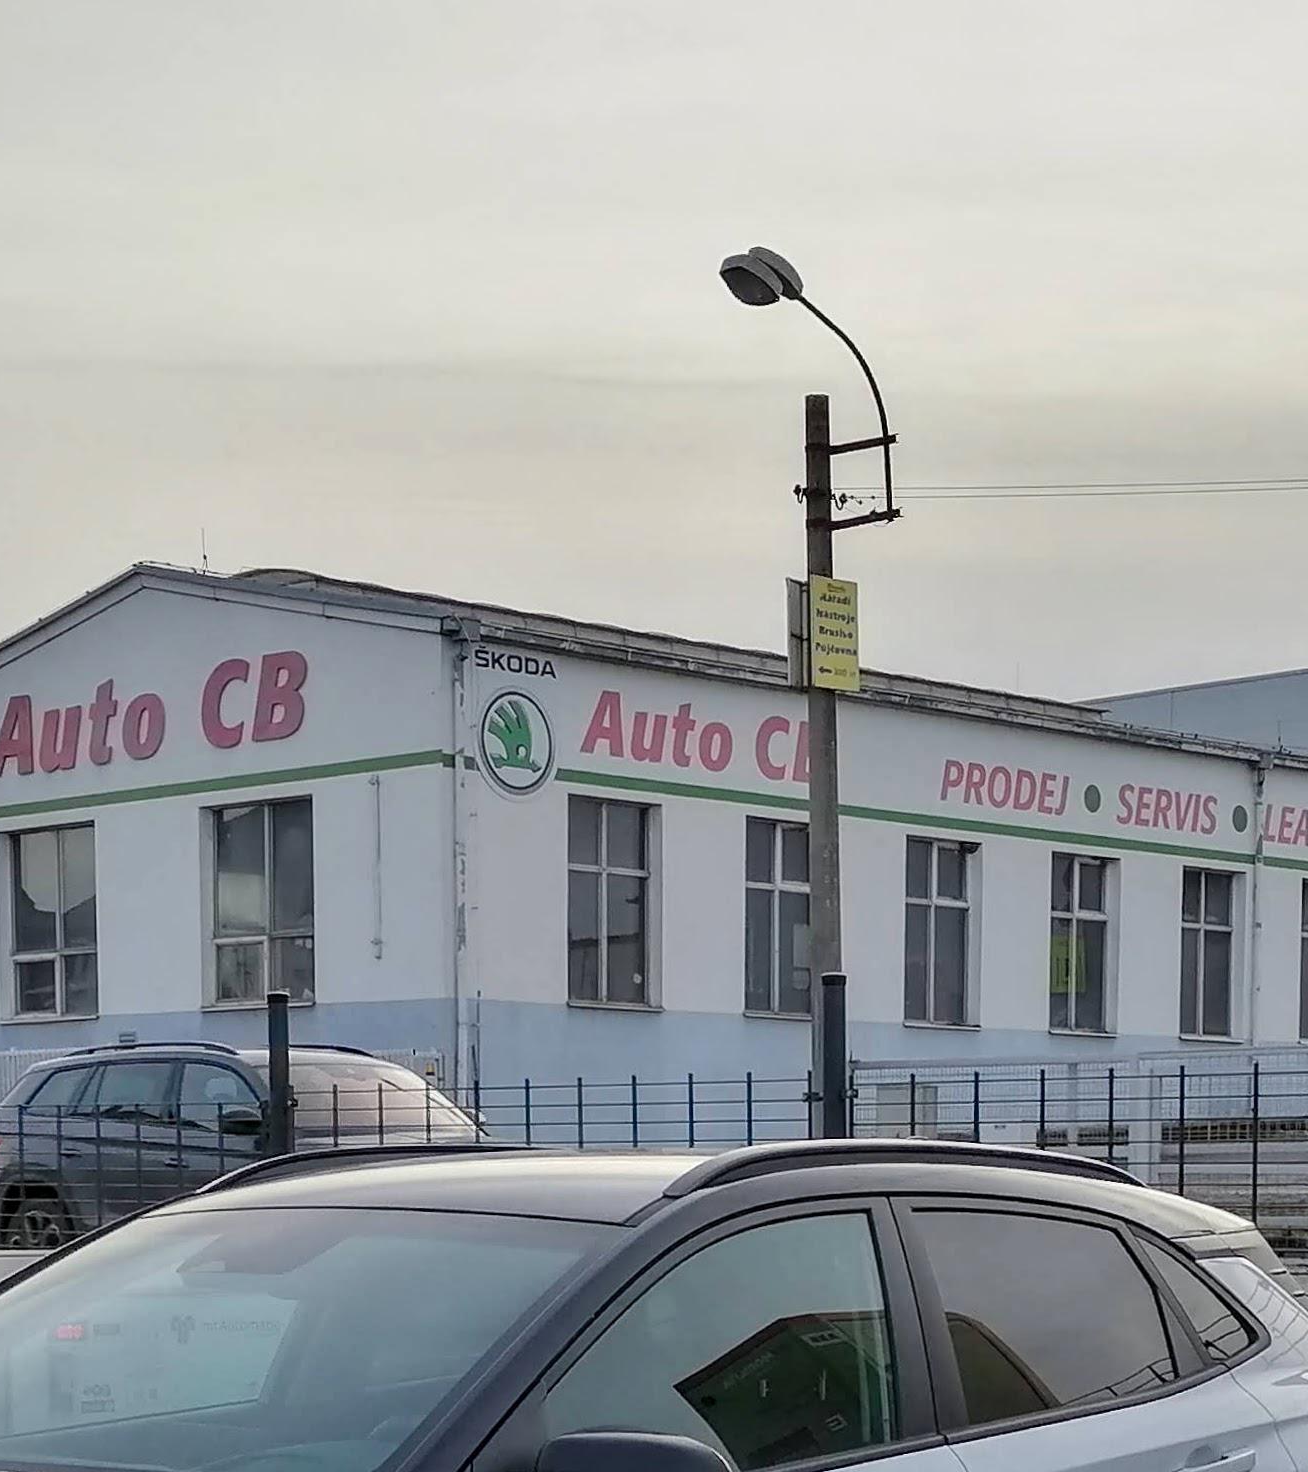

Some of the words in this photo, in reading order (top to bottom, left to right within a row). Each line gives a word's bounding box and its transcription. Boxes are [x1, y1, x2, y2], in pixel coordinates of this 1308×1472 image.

[201, 650, 308, 749] CB
[475, 647, 557, 679] ŠKODA
[580, 690, 734, 772] Auto
[940, 759, 1071, 817] PRODEJ
[1116, 783, 1218, 835] SERVIS
